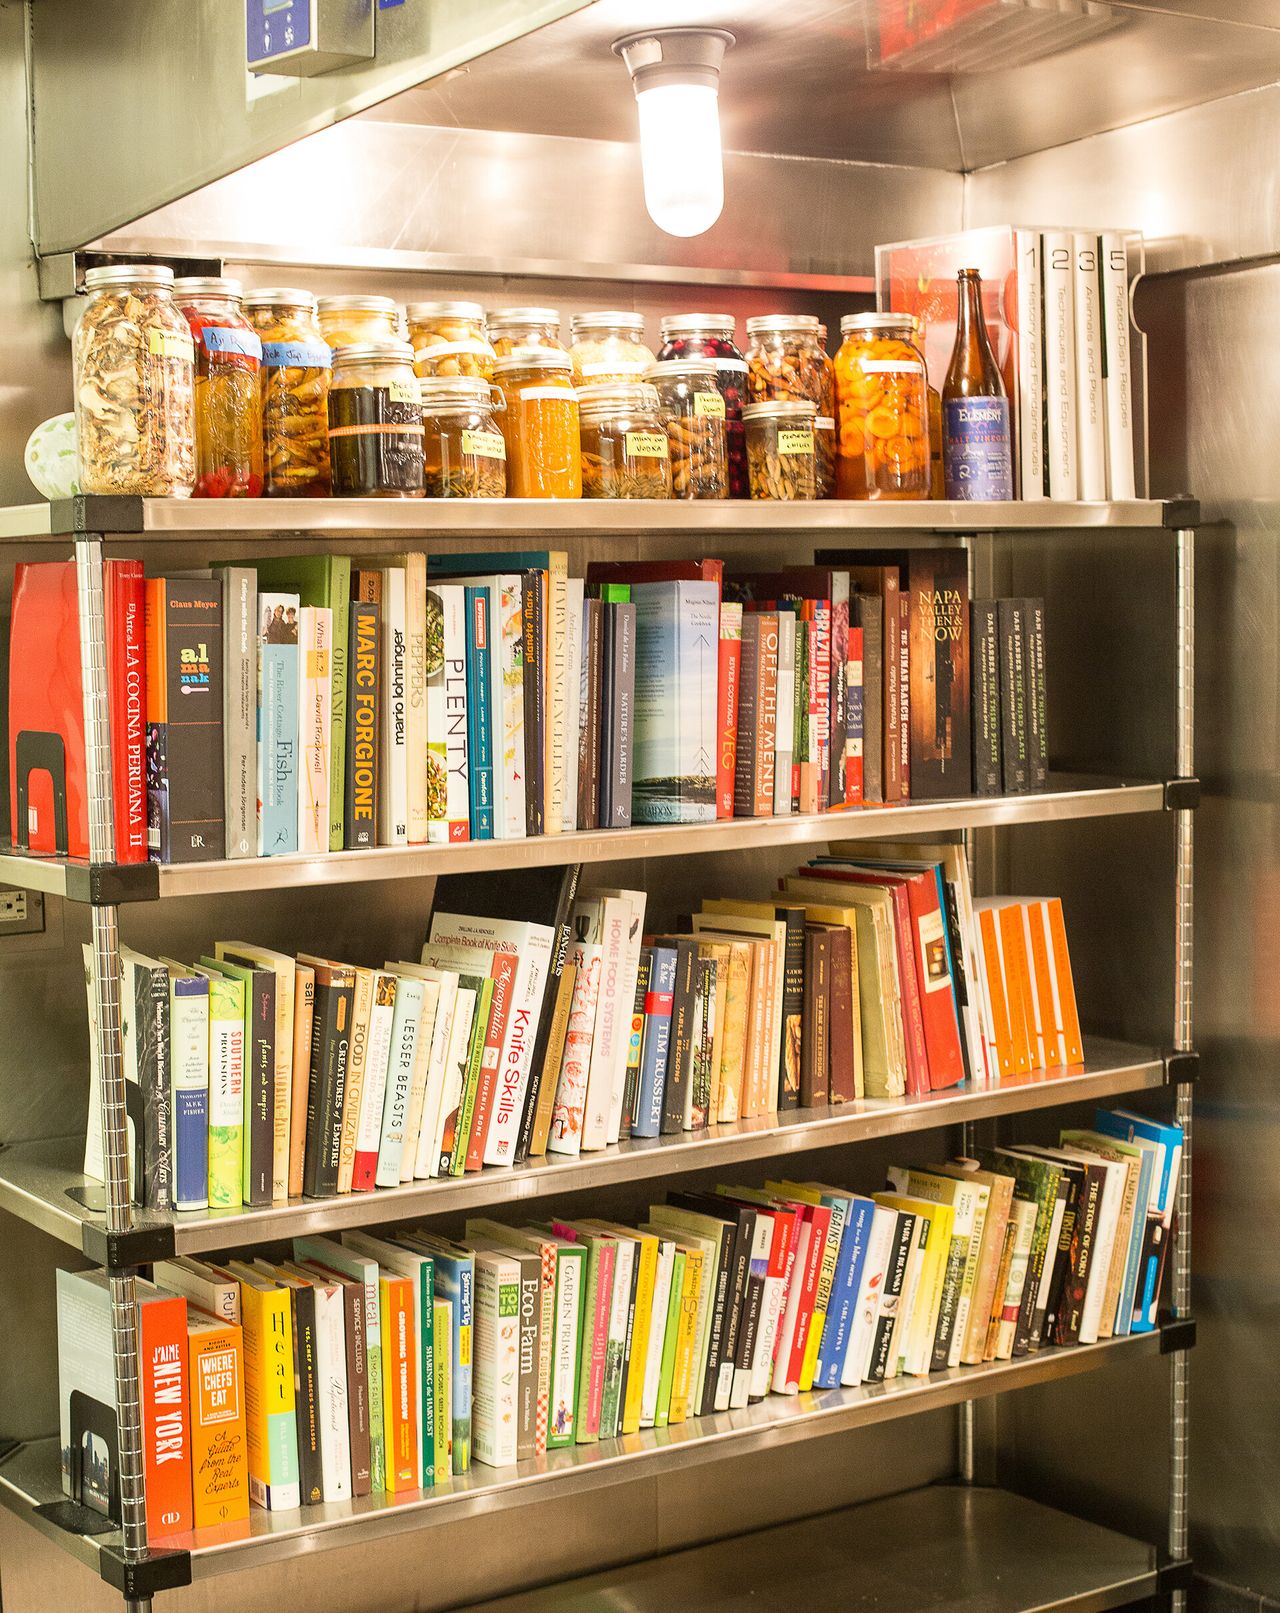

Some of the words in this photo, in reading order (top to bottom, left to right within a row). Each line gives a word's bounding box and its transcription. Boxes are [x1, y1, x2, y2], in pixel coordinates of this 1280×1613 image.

[1025, 247, 1036, 268] 1
[1052, 249, 1069, 270] 2
[1079, 250, 1095, 271] 3
[1110, 250, 1125, 270] 5
[1028, 283, 1039, 336] History
[1058, 287, 1067, 363] Techniques
[1087, 285, 1096, 342] Animals
[1117, 285, 1127, 367] Plated-Dish
[1030, 342, 1038, 368] and
[1089, 347, 1098, 374] and
[1060, 369, 1068, 396] and
[1120, 372, 1130, 429] Recipes
[1090, 379, 1099, 425] Plants
[1031, 374, 1040, 476] Fundamentals
[1060, 401, 1070, 478] Equipment
[128, 603, 136, 612] El
[170, 600, 193, 608] Claus
[523, 591, 535, 618] Marx
[919, 590, 962, 604] NAPA
[919, 605, 962, 615] VALLEY
[126, 612, 136, 634] Arte
[919, 616, 954, 626] THEN
[954, 616, 963, 626] &
[920, 627, 963, 641] NOW
[986, 613, 994, 634] DAN
[126, 644, 140, 667] LA
[180, 643, 209, 663] al
[180, 663, 210, 674] ma
[276, 660, 285, 679] The
[355, 615, 376, 687] MARC
[392, 629, 406, 699] lohninger
[728, 656, 736, 683] RIVER
[765, 632, 778, 677] OFF
[900, 648, 909, 682] NIMAN
[987, 636, 996, 674] BARBER
[180, 673, 210, 683] nak
[332, 647, 344, 729] ORGANIC
[410, 633, 424, 708] PEPPERS
[989, 676, 997, 696] THE
[127, 670, 141, 740] COCINA
[277, 680, 285, 702] River
[727, 684, 735, 727] COTTAGE
[764, 684, 777, 723] THE
[900, 684, 909, 721] RANCH
[275, 704, 285, 738] Cottage
[393, 702, 405, 745] mario
[446, 659, 467, 780] PLENTY
[620, 692, 630, 742] NATURE'S
[990, 699, 998, 730] THIRD
[276, 739, 293, 783] Fish
[314, 726, 323, 774] Rockwell
[353, 694, 376, 821] FORGIONE
[721, 727, 736, 769] VEG
[901, 722, 909, 765] COOKBOOK
[991, 732, 999, 764] PLATE
[619, 744, 628, 785] LARDER
[763, 729, 776, 797] MENU
[128, 744, 142, 825] PERUANA
[276, 785, 286, 806] Book
[129, 833, 143, 846] II
[554, 924, 571, 977] JEAN-LOUIS
[608, 919, 622, 959] HOME
[303, 982, 314, 1007] salt
[604, 961, 618, 998] FOOD
[490, 959, 513, 1041] Mycophilia
[504, 1008, 531, 1063] Knife
[600, 1001, 614, 1058] SYSTEMS
[656, 1021, 669, 1051] TIM
[676, 1007, 685, 1040] TABLE
[257, 1039, 273, 1068] plants
[352, 1023, 367, 1067] FOOD
[399, 1018, 415, 1068] LESSER
[220, 1032, 228, 1095] PROVISIONS
[230, 1030, 242, 1095] SOUTHERN
[335, 1039, 350, 1110] CREATURES
[350, 1071, 362, 1082] IN
[673, 1043, 683, 1083] BECKONS
[257, 1091, 268, 1121] empire
[391, 1075, 407, 1128] BEASTS
[478, 1074, 491, 1110] EUGENIA
[496, 1068, 520, 1124] Skills
[649, 1057, 667, 1127] RUSSERT
[342, 1087, 360, 1166] CIVILIZATION
[475, 1113, 484, 1136] BONE
[330, 1123, 342, 1168] EMPIRE
[1091, 1181, 1099, 1200] THE
[828, 1204, 844, 1247] AGAINST
[1086, 1201, 1096, 1236] STORY
[811, 1236, 821, 1269] TERCEIRO
[825, 1251, 836, 1273] THE
[950, 1240, 962, 1278] PROJECT
[1083, 1237, 1091, 1250] OF
[688, 1255, 703, 1296] Raising
[735, 1256, 745, 1292] CULTURE
[807, 1269, 816, 1292] PRATO
[1078, 1252, 1088, 1278] CORN
[501, 1294, 518, 1305] TO
[561, 1264, 574, 1320] GARDEN
[720, 1271, 728, 1300] CONSULTING
[768, 1281, 780, 1315] FOOD
[815, 1276, 831, 1313] GRAIN
[945, 1281, 957, 1315] ANIMAL
[353, 1298, 361, 1331] SERVICE
[364, 1282, 377, 1328] meat
[500, 1306, 519, 1315] EAT
[542, 1290, 552, 1337] GARDENING
[684, 1299, 698, 1336] Steaks
[715, 1312, 724, 1331] GENIUS
[398, 1311, 407, 1358] GROWING
[520, 1278, 539, 1375] Eco-Farm
[726, 1305, 738, 1358] AGRICULTURE
[761, 1316, 774, 1368] POLITICS
[940, 1316, 950, 1341] FARM
[152, 1343, 180, 1364] J'AIME
[201, 1355, 234, 1374] WHERE
[354, 1334, 363, 1374] INCLUDED
[540, 1341, 549, 1353] BY
[560, 1322, 573, 1371] PRIMER
[709, 1351, 717, 1368] PLACE
[153, 1362, 182, 1404] NEW
[204, 1372, 233, 1391] CHEFS
[370, 1354, 379, 1382] SIMON
[425, 1345, 433, 1386] SHARING
[538, 1355, 548, 1393] CUISINE
[211, 1389, 227, 1407] EAT
[371, 1386, 380, 1419] FAIRLIE
[399, 1361, 408, 1420] TOMORROW
[309, 1404, 317, 1451] SAMUELSSON
[426, 1396, 434, 1438] HARVEST
[154, 1410, 184, 1466] YORK
[208, 1437, 241, 1458] Guide
[199, 1454, 229, 1473] from
[229, 1453, 242, 1466] the
[213, 1466, 233, 1481] Real
[205, 1480, 241, 1496] Experts
